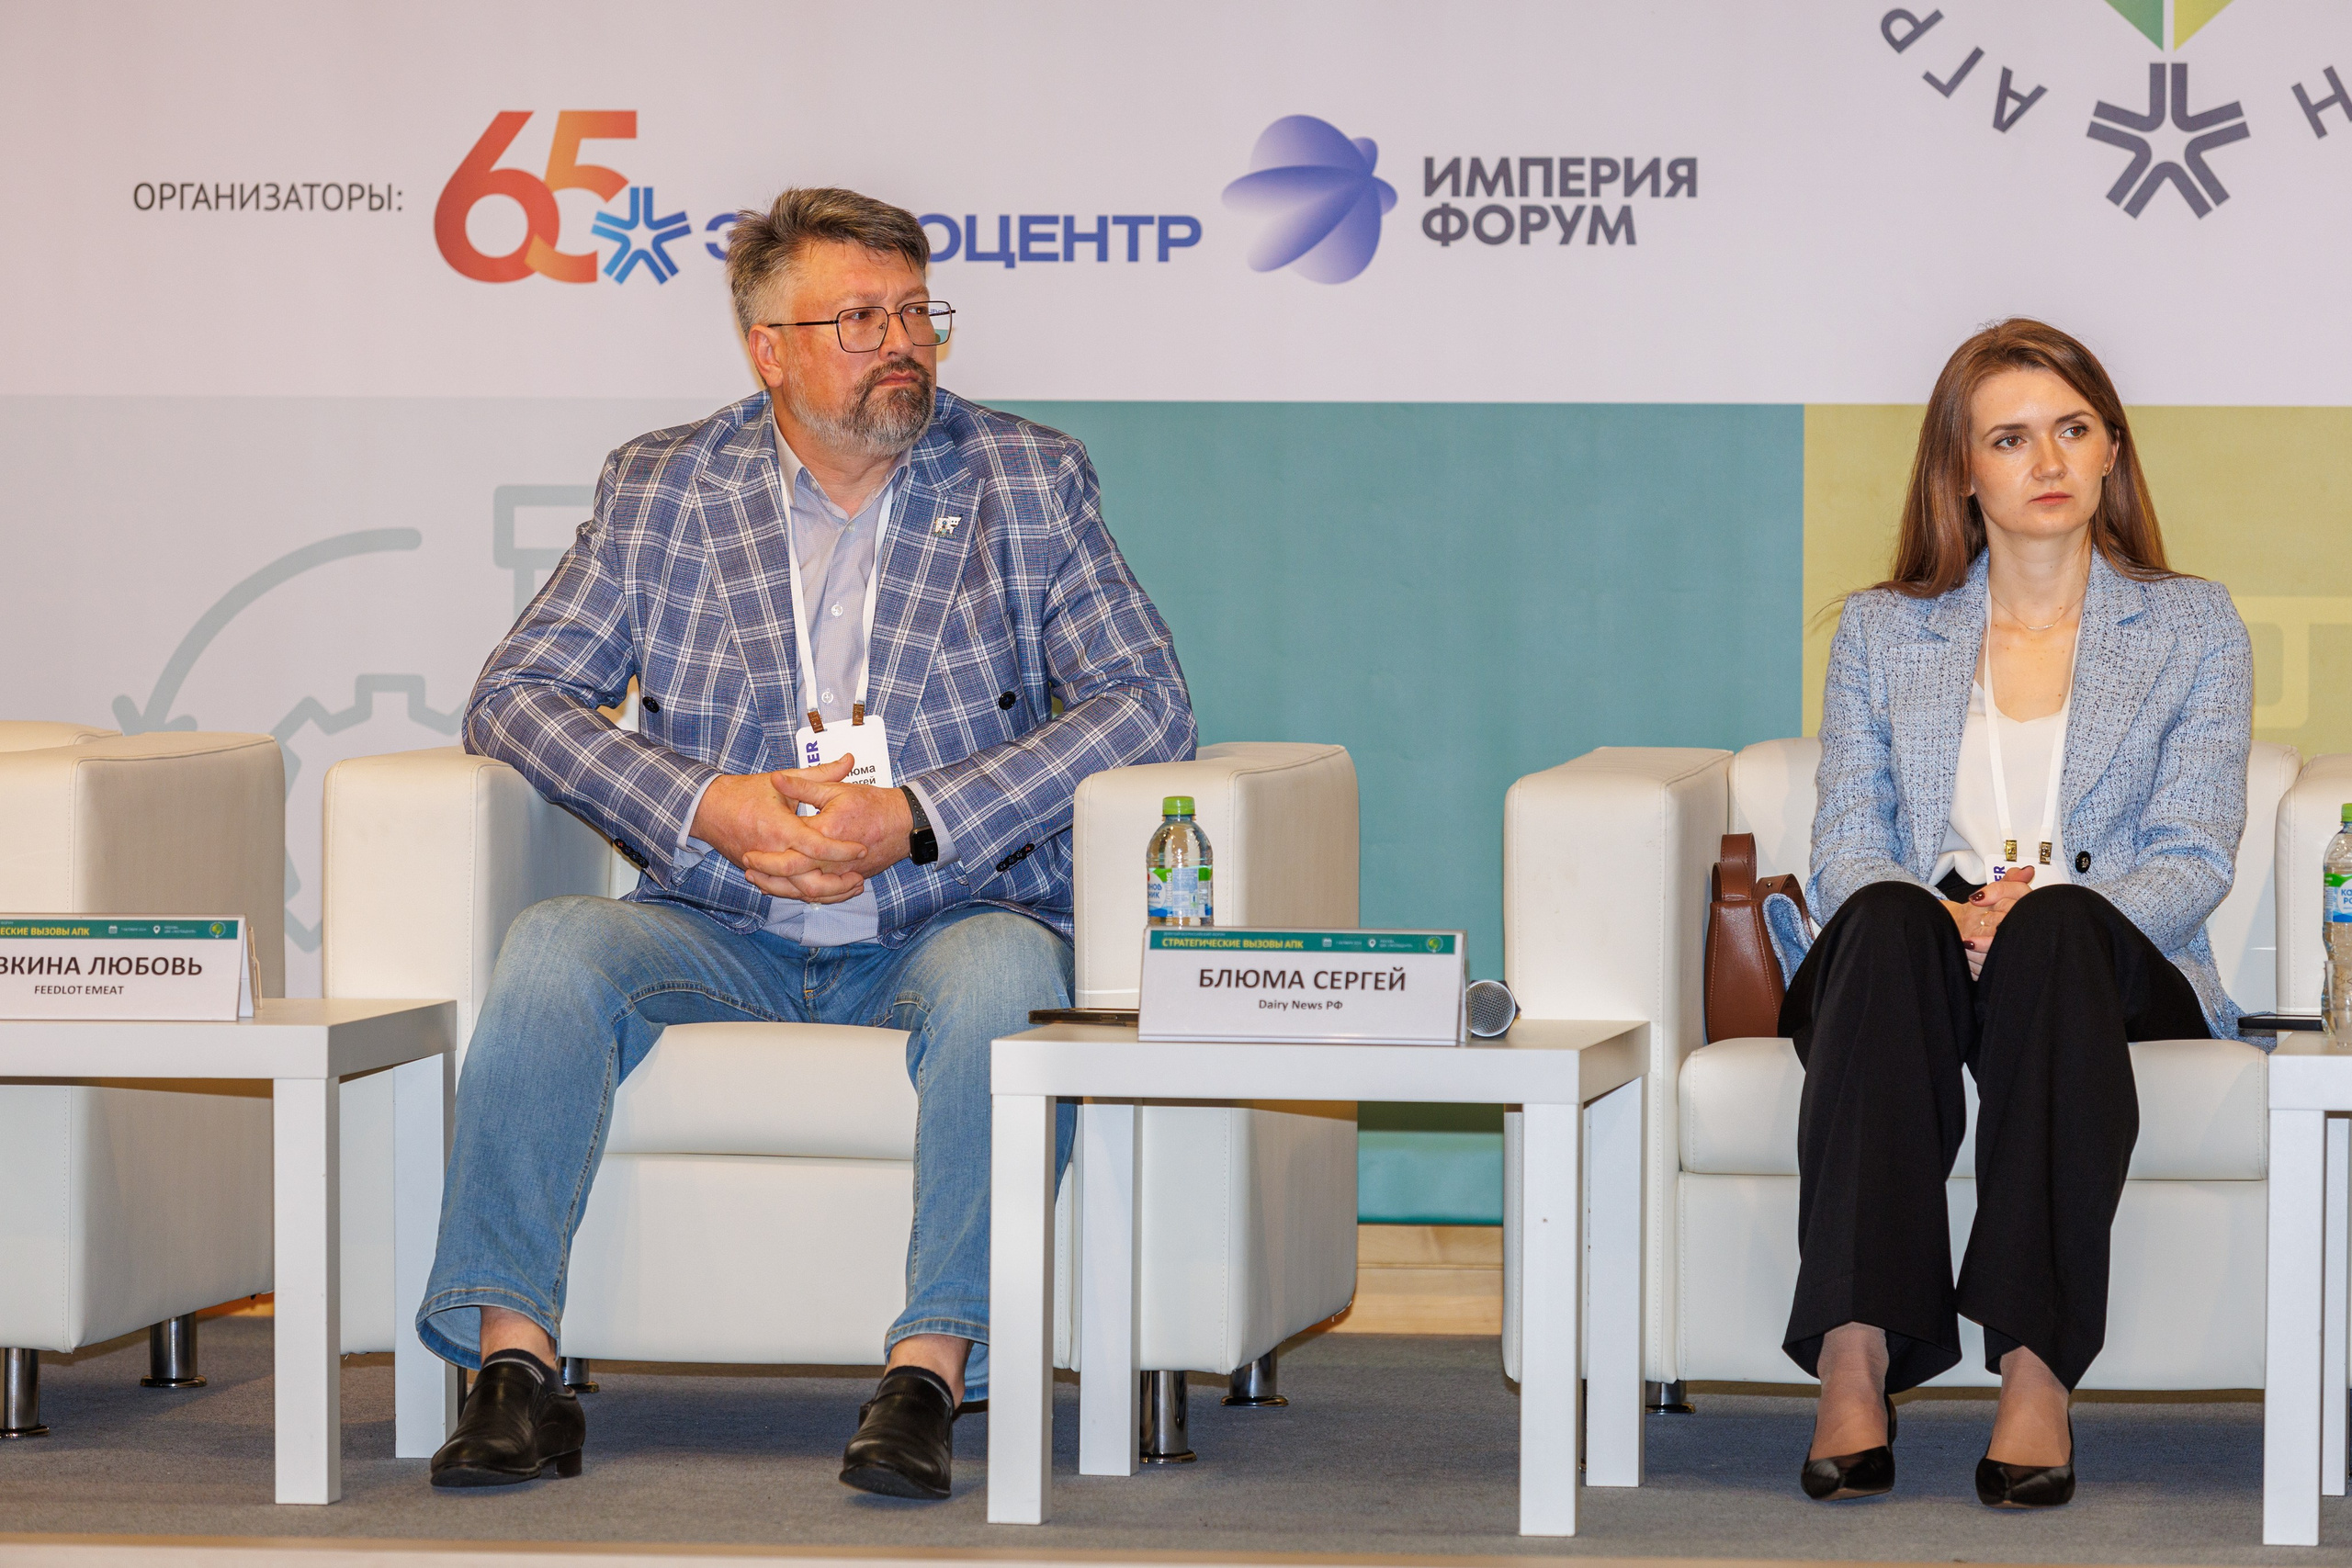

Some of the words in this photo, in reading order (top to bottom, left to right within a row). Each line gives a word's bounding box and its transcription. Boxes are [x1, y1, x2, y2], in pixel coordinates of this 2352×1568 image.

[1424, 156, 1698, 198] ИМПЕРИЯ
[133, 182, 402, 212] ОРГАНИЗАТОРЫ:
[434, 109, 638, 284] 65
[1421, 202, 1638, 247] ФОРУМ
[806, 740, 820, 768] ER
[30, 927, 70, 936] ВЫЗОВЫ
[72, 927, 90, 937] АПК
[1162, 937, 1241, 948] СТРАТЕГИЧЕСКИЕ
[1243, 939, 1283, 949] ВЫЗОВЫ
[1284, 940, 1304, 949] АПК
[87, 956, 203, 976] ЛЮБОВЬ
[1199, 968, 1306, 989] БЛЮМА
[1313, 966, 1406, 991] СЕРГЕЙ
[34, 985, 84, 995] FEEDLOT
[85, 986, 125, 995] EMEAT
[1259, 999, 1289, 1011] Dairy
[1291, 999, 1323, 1010] News
[1326, 1000, 1343, 1011] РФ
